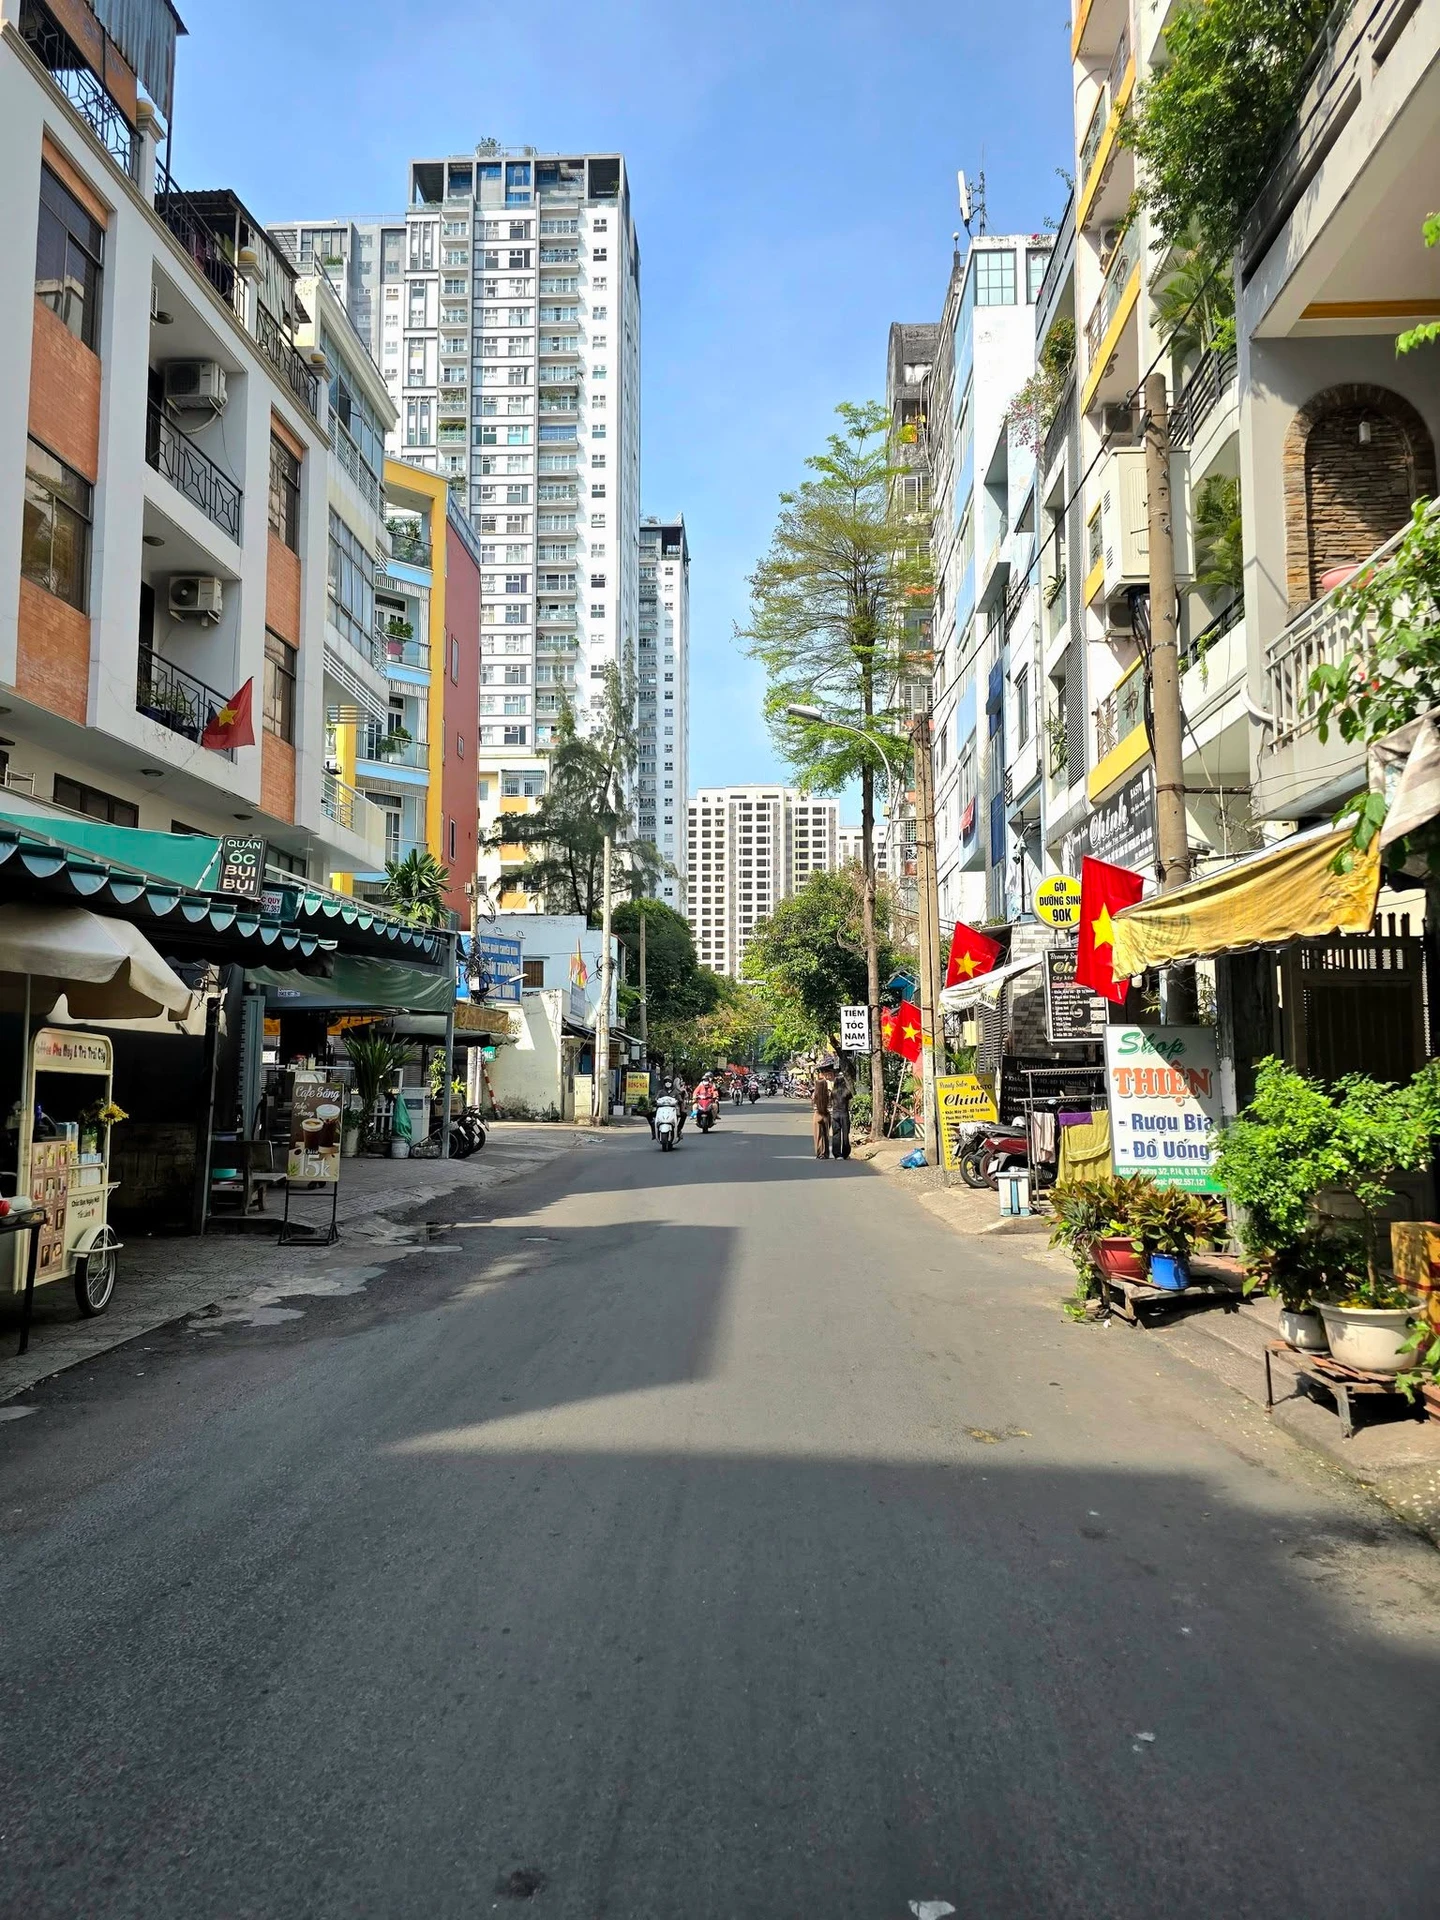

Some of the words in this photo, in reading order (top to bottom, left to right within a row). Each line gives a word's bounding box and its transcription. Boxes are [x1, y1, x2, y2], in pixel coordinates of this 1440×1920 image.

[227, 838, 261, 849] QUÁN
[229, 849, 256, 865] ỐC
[224, 865, 256, 879] BỤI
[222, 878, 255, 893] BỤI
[1054, 880, 1067, 893] GỘI
[1039, 894, 1064, 906] DƯỠNG
[1052, 908, 1072, 922] 90K
[845, 1020, 864, 1029] TÓC
[1117, 1032, 1186, 1059] Shop
[1112, 1060, 1212, 1105] THIỆN
[944, 1092, 989, 1106] Chinh
[1131, 1113, 1178, 1135] Rượu
[1184, 1113, 1214, 1131] Bia
[1133, 1139, 1159, 1158] Đồ
[1163, 1139, 1211, 1161] Uống
